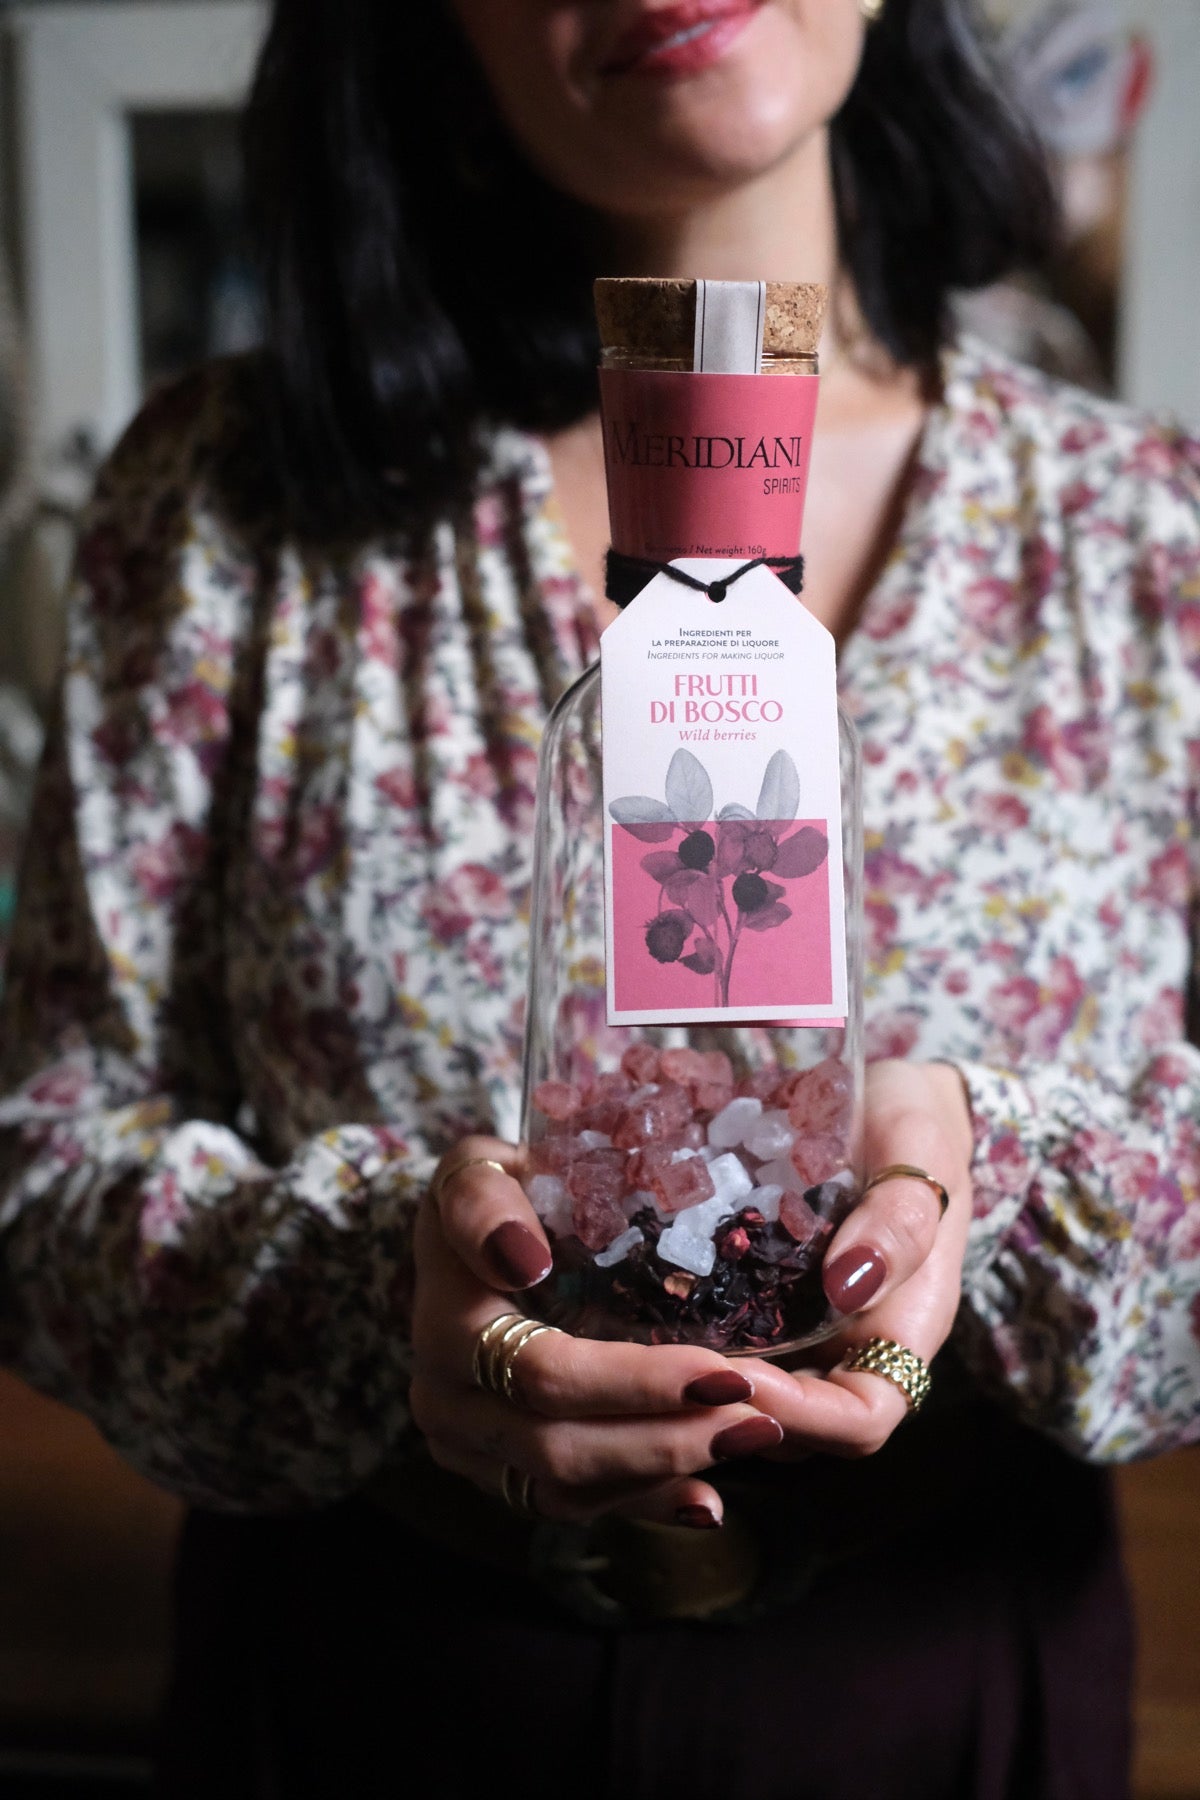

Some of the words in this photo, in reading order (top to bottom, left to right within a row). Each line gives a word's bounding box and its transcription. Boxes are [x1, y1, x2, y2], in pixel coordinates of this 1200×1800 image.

[610, 420, 802, 469] MERIDIANI
[763, 477, 801, 495] SPIRITS
[696, 545, 713, 554] Net
[715, 545, 745, 557] weight:
[748, 545, 767, 557] 160g
[679, 627, 734, 638] INGREDIENTI
[736, 629, 752, 638] PER
[652, 639, 663, 647] LA
[664, 639, 728, 647] PREPARAZIONE
[730, 639, 740, 647] DI
[742, 639, 780, 648] LIQUORE
[647, 650, 700, 660] INGREDIENTS
[702, 652, 719, 660] FOR
[720, 652, 752, 660] MAKING
[754, 652, 785, 661] LIQUOR
[674, 674, 758, 697] FRUTTI
[650, 700, 675, 724] DI
[685, 700, 784, 723] BOSCO
[679, 729, 710, 741] Wild
[713, 728, 757, 741] berries
